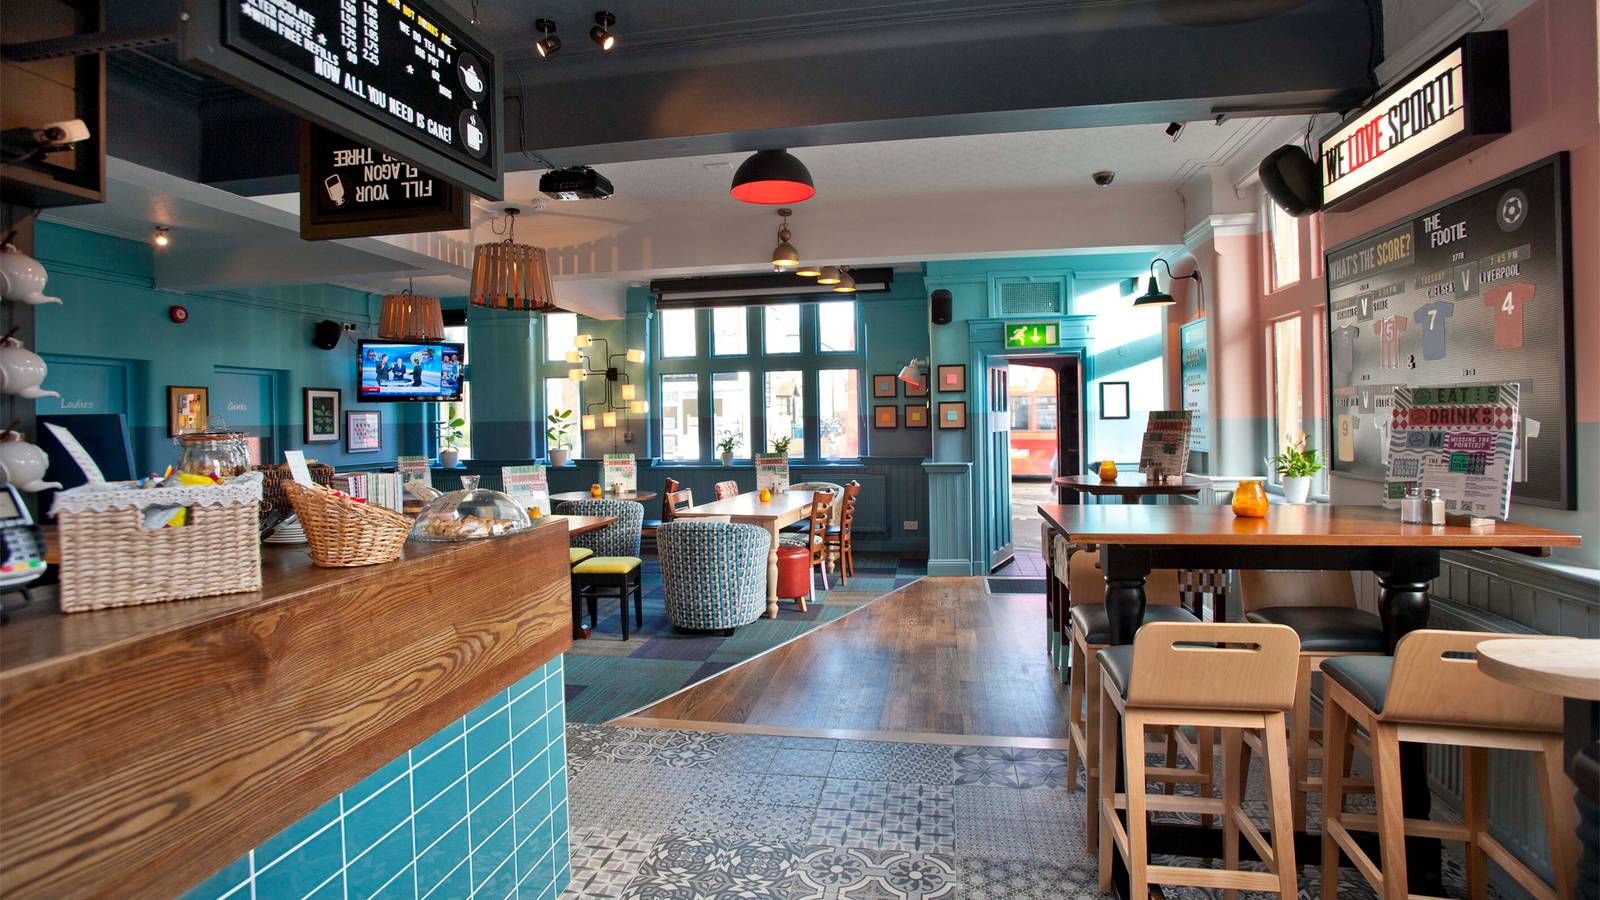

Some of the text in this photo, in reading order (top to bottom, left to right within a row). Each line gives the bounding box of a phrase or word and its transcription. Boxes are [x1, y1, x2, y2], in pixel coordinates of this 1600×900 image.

[278, 10, 314, 40] COFFEE
[278, 22, 303, 47] FREE
[303, 37, 339, 66] REFILLS
[423, 38, 436, 54] TEA
[446, 53, 451, 64] A
[427, 54, 439, 68] POT
[314, 56, 451, 144] NOW ALL YOU NEED IS CAKE!
[1325, 67, 1454, 184] WE LOVE SPORT!
[333, 147, 374, 167] THREE
[364, 163, 418, 182] FLAGON
[356, 180, 432, 202] FILL YOUR
[1423, 213, 1441, 234] THE
[1431, 221, 1468, 248] FOOTIE
[1330, 234, 1411, 280] WHAT'S THE SCORE?
[1461, 269, 1470, 292] V
[1479, 264, 1521, 283] LIVERPOOL
[1361, 298, 1368, 316] V
[1501, 291, 1515, 315] 4
[1427, 309, 1437, 331] 7
[1386, 322, 1394, 341] 5
[61, 397, 96, 409] Ladies
[227, 401, 248, 411] Gents
[1362, 391, 1369, 409] V
[1437, 388, 1469, 404] EAT
[1430, 409, 1479, 425] DRINK
